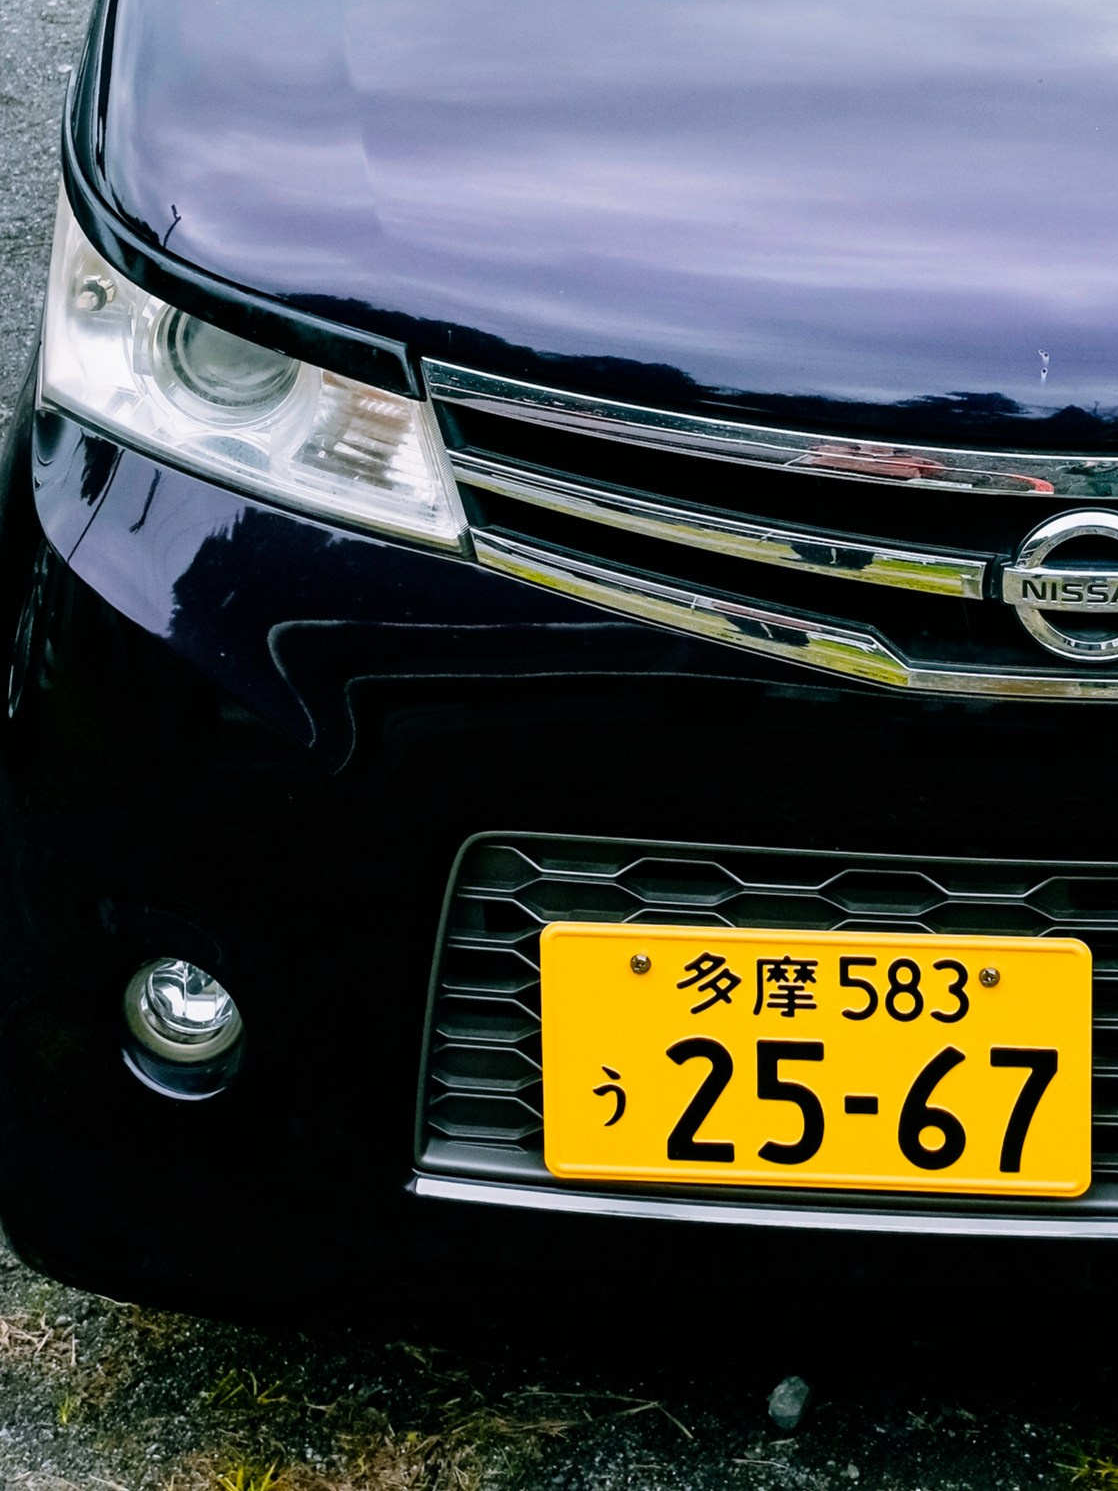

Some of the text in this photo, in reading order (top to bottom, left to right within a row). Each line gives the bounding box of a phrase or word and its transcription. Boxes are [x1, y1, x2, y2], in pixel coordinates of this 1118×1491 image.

[676, 951, 970, 1024] 多摩 583
[592, 1036, 1059, 1174] う 25-67
